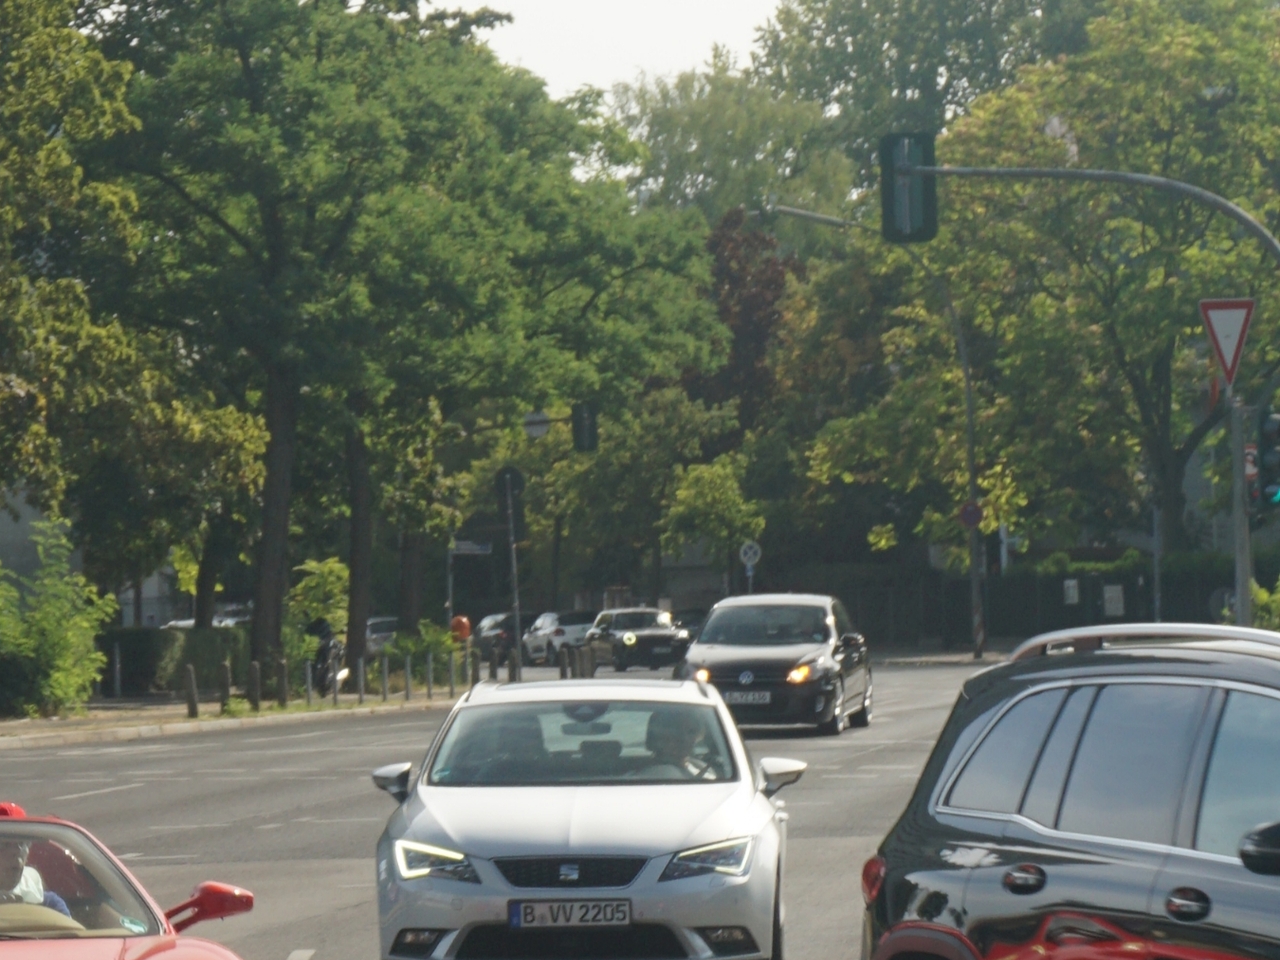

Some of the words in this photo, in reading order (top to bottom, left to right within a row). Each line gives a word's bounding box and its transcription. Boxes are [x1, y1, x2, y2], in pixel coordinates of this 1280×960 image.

[522, 904, 535, 924] B
[549, 904, 574, 923] VV
[578, 902, 627, 923] 2205
